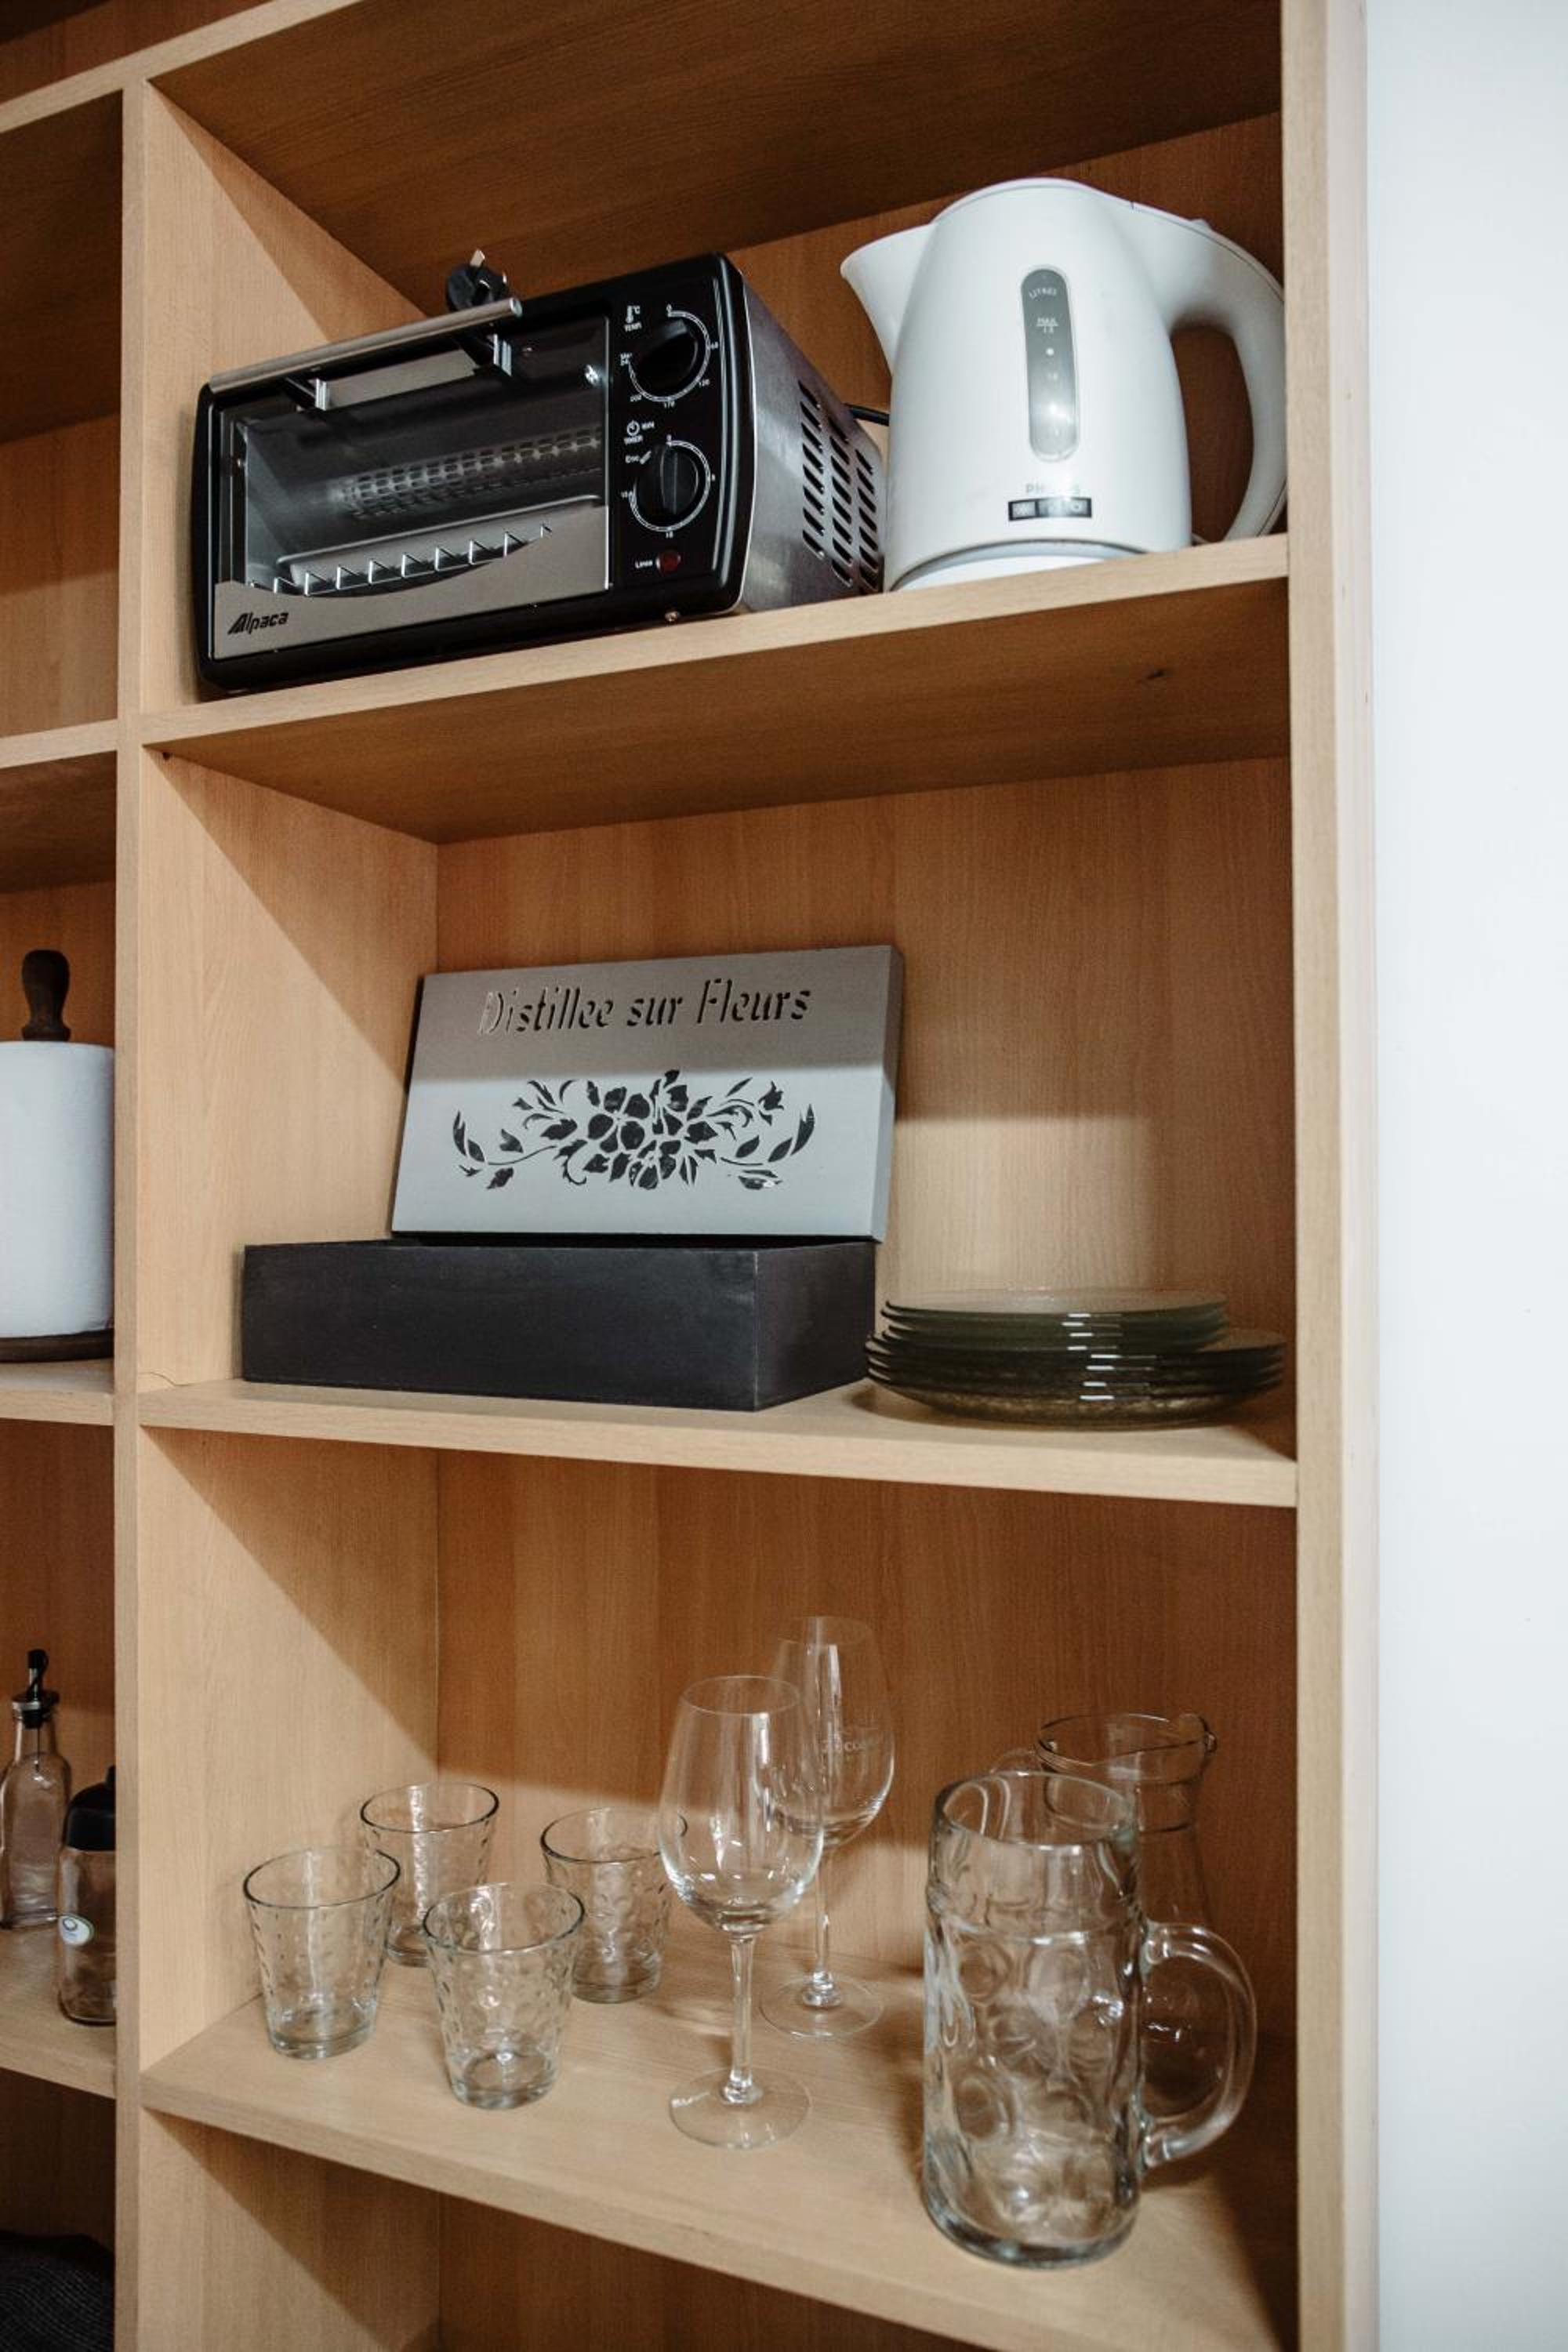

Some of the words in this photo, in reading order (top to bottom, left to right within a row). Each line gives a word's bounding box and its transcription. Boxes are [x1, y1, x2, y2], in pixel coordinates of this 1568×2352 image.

[227, 612, 289, 635] Alpaca
[477, 985, 615, 1036] Distillee
[626, 996, 684, 1027] sur
[695, 978, 812, 1024] Fleurs
